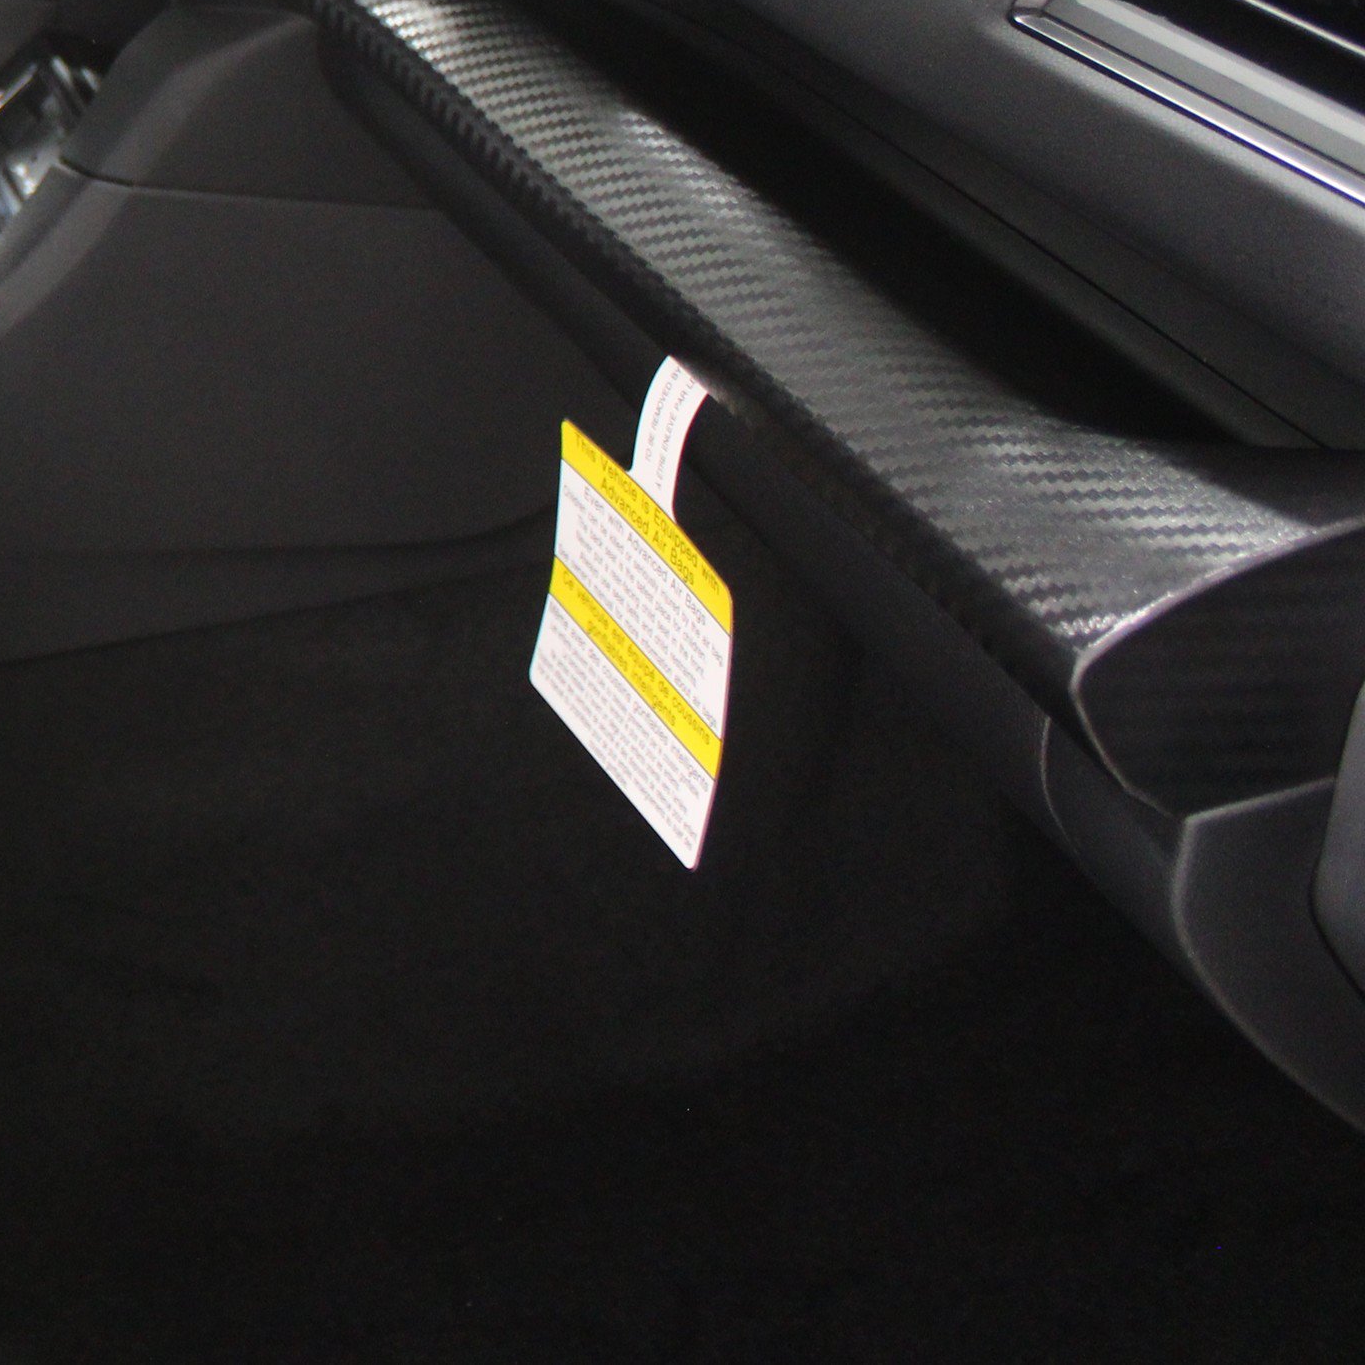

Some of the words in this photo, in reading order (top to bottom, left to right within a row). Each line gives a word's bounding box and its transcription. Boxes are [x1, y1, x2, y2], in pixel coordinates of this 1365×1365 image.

[653, 384, 672, 431] REMOVED
[672, 367, 682, 381] BY
[675, 391, 688, 411] PAR
[574, 430, 596, 464] This
[601, 455, 637, 504] Vehicle
[640, 496, 650, 516] is
[652, 507, 698, 570] Equipped
[700, 564, 720, 595] with
[583, 485, 604, 516] Even
[607, 510, 623, 536] with
[626, 530, 667, 582] Advanced
[670, 577, 682, 598] Air
[684, 592, 706, 628] Bags
[601, 477, 649, 537] Advanced
[652, 529, 666, 555] Air
[669, 547, 695, 590] Bags
[562, 569, 573, 592] Ce
[611, 625, 624, 648] est
[626, 640, 655, 685] équipé
[657, 676, 669, 699] de
[671, 692, 710, 746] coussins
[586, 616, 628, 677] gonflables
[630, 667, 676, 731] intelligents
